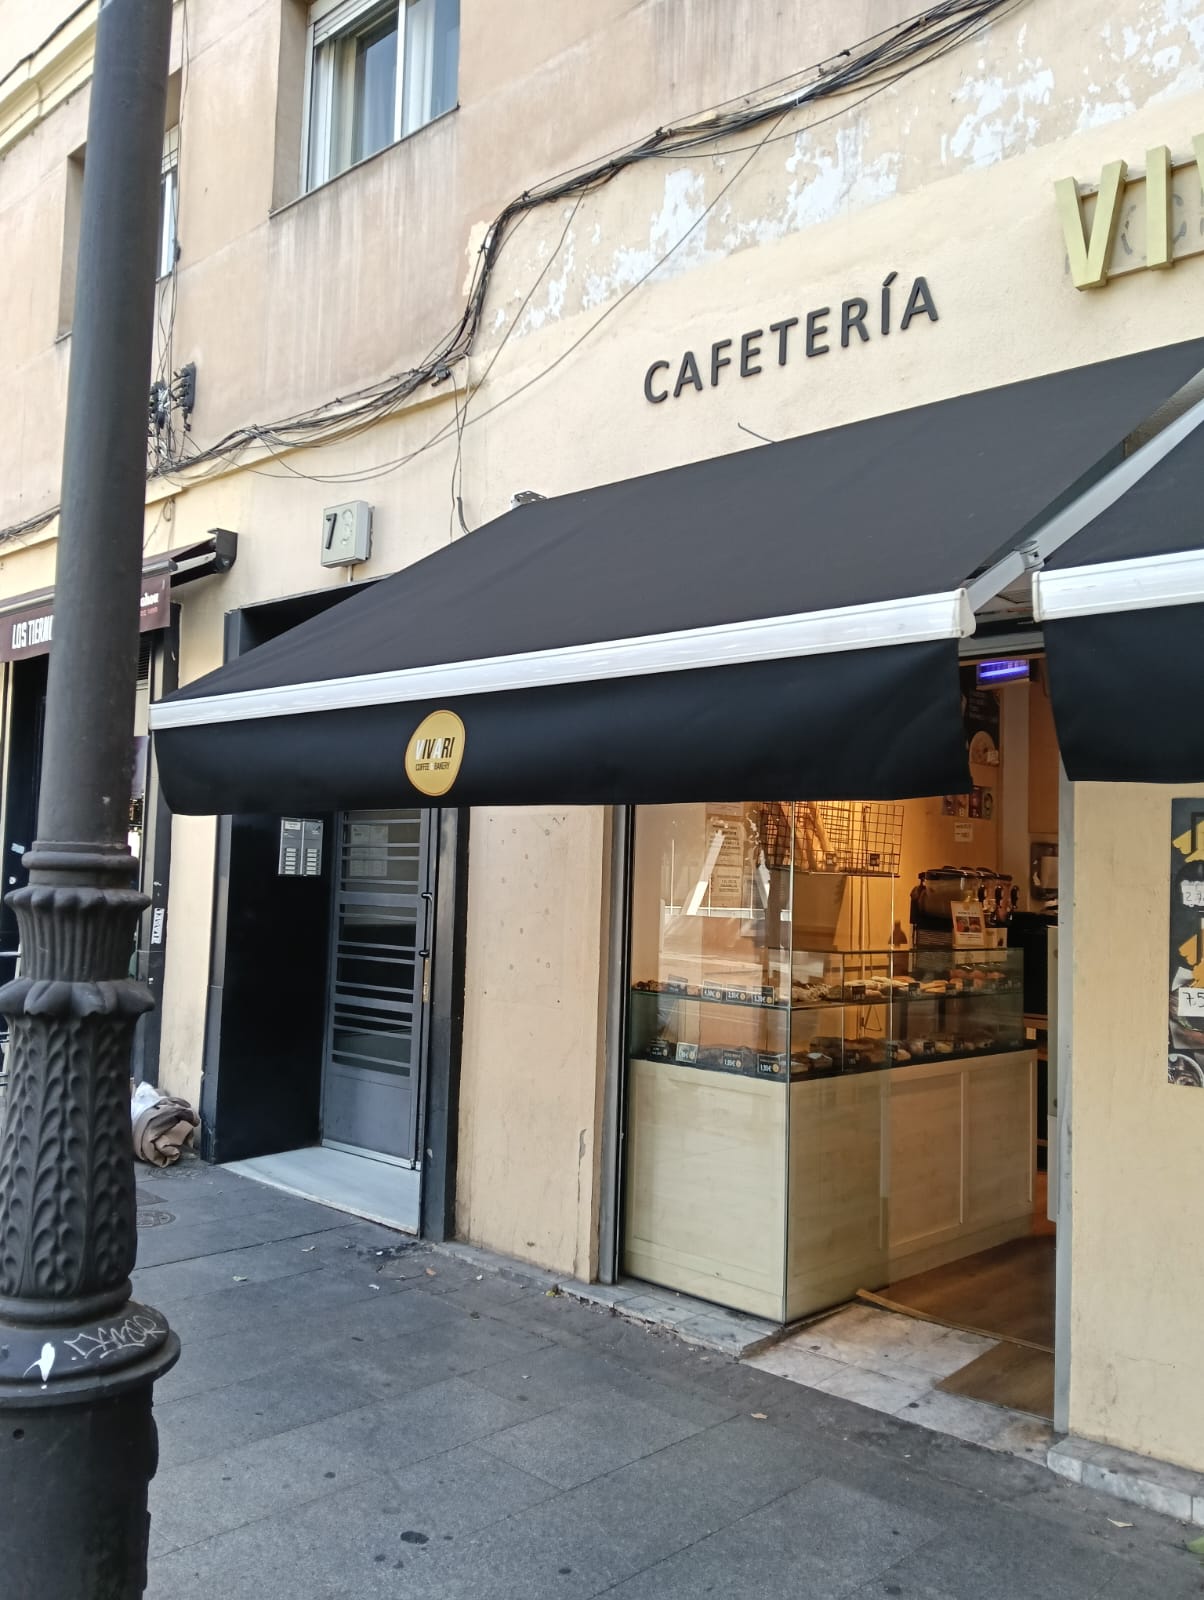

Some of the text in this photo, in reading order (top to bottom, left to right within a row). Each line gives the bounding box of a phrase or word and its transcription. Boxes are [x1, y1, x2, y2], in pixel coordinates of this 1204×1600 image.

[643, 270, 940, 404] CAFETERÍA
[12, 621, 28, 649] LOS
[415, 737, 455, 761] VIVARI
